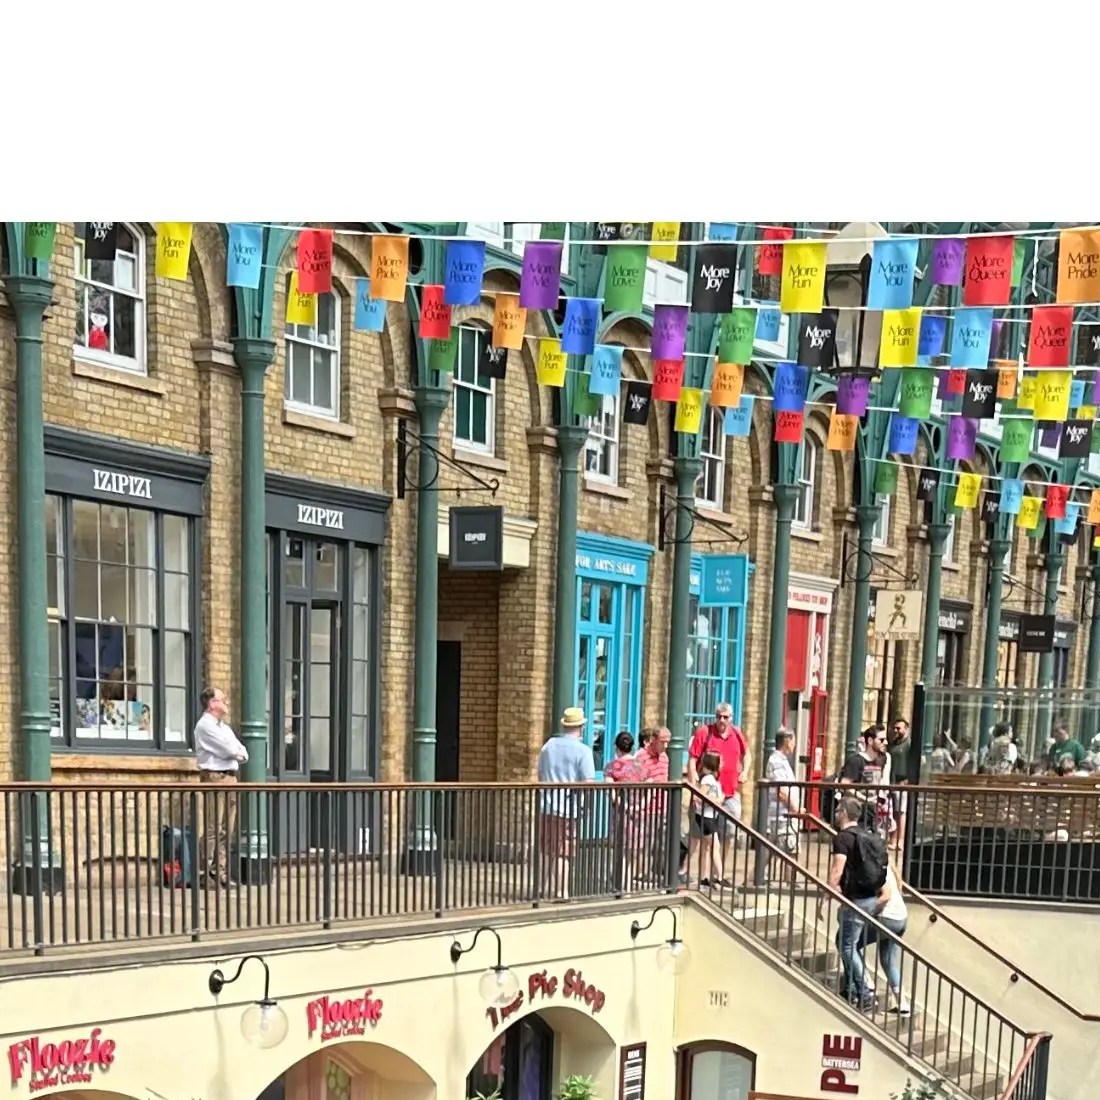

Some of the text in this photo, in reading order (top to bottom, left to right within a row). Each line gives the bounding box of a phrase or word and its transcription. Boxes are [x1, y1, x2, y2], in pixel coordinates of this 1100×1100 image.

[94, 230, 107, 241] Joy
[162, 237, 184, 248] More
[163, 247, 178, 258] Fun
[232, 244, 255, 255] More
[305, 250, 327, 260] More
[234, 254, 250, 265] You
[377, 257, 402, 269] More
[973, 255, 1005, 267] More
[1068, 253, 1100, 265] More
[452, 260, 477, 272] More
[612, 266, 638, 276] More
[789, 265, 817, 277] More
[877, 262, 907, 273] More
[376, 269, 399, 279] Pride
[701, 266, 729, 278] More
[969, 268, 1006, 283] Queer
[1068, 265, 1097, 279] Pride
[612, 277, 635, 286] Love
[706, 277, 722, 291] Joy
[791, 277, 811, 288] Fun
[884, 273, 904, 286] You
[806, 327, 831, 338] More
[889, 325, 914, 336] More
[960, 327, 985, 338] More
[1038, 325, 1065, 336] More
[810, 337, 825, 349] Joy
[892, 336, 910, 346] Fun
[963, 338, 978, 348] You
[1034, 336, 1066, 348] Queer
[543, 352, 562, 361] More
[544, 360, 558, 369] Fun
[970, 382, 992, 393] More
[1040, 384, 1064, 394] More
[973, 392, 986, 403] Joy
[1043, 393, 1059, 402] Fun
[1067, 427, 1088, 436] More
[92, 469, 152, 499] IZIPIZI
[297, 504, 344, 530] IZIPIZI
[528, 967, 558, 1004] Pie
[562, 968, 605, 1015] Shop
[306, 988, 383, 1032] Floozie
[8, 1028, 116, 1080] Floozie
